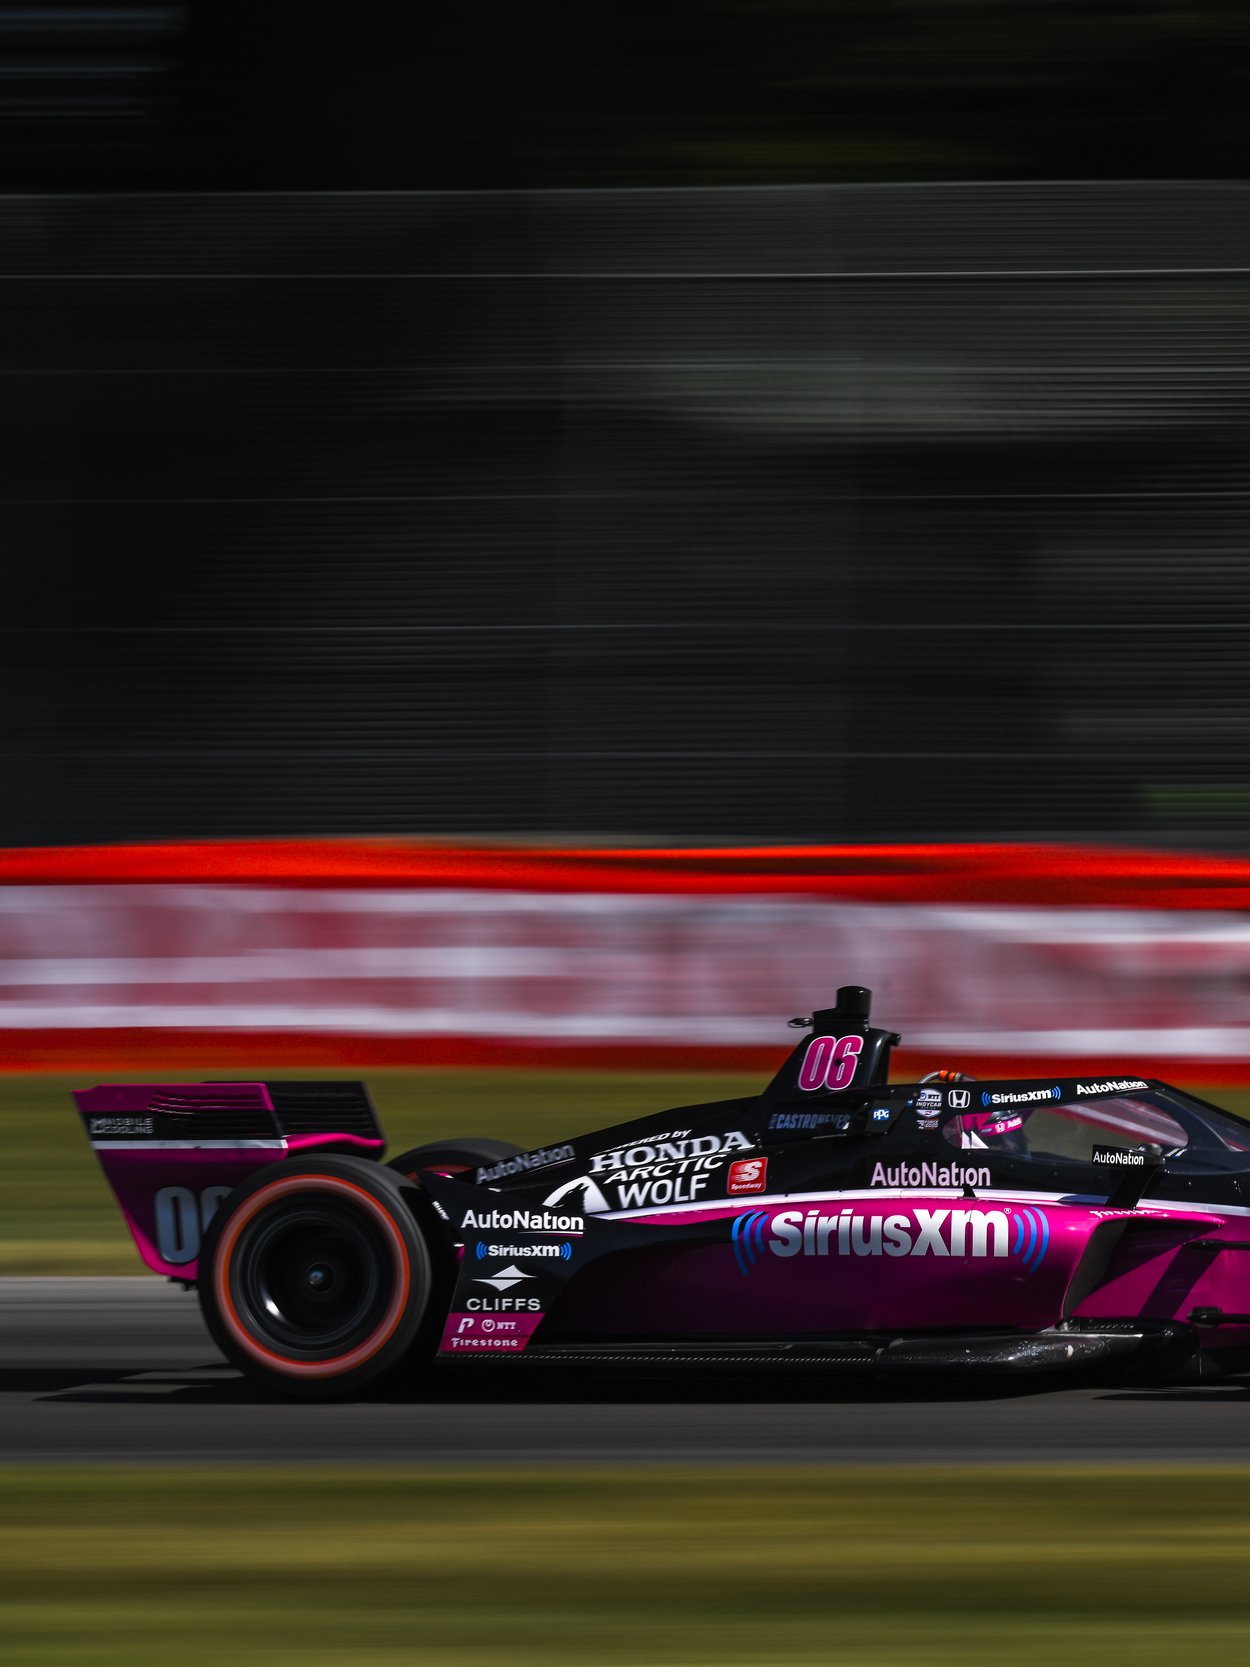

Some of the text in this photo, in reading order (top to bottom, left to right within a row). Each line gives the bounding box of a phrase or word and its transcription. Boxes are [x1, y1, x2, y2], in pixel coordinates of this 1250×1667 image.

[798, 1035, 864, 1091] 06
[1076, 1080, 1147, 1095] AutoNation
[873, 1109, 889, 1120] PPG
[589, 1131, 755, 1173] HONDA
[1093, 1151, 1144, 1165] AutoNation
[476, 1145, 576, 1184] AutoNation
[603, 1154, 727, 1184] ARCTIC
[870, 1161, 991, 1187] AutoNation
[617, 1173, 711, 1209] WOLF
[731, 1182, 762, 1190] Speedway
[461, 1209, 584, 1230] AutoNation
[466, 1298, 541, 1311] CLIFFS
[497, 1321, 516, 1330] NTT
[451, 1338, 518, 1347] Firestone
